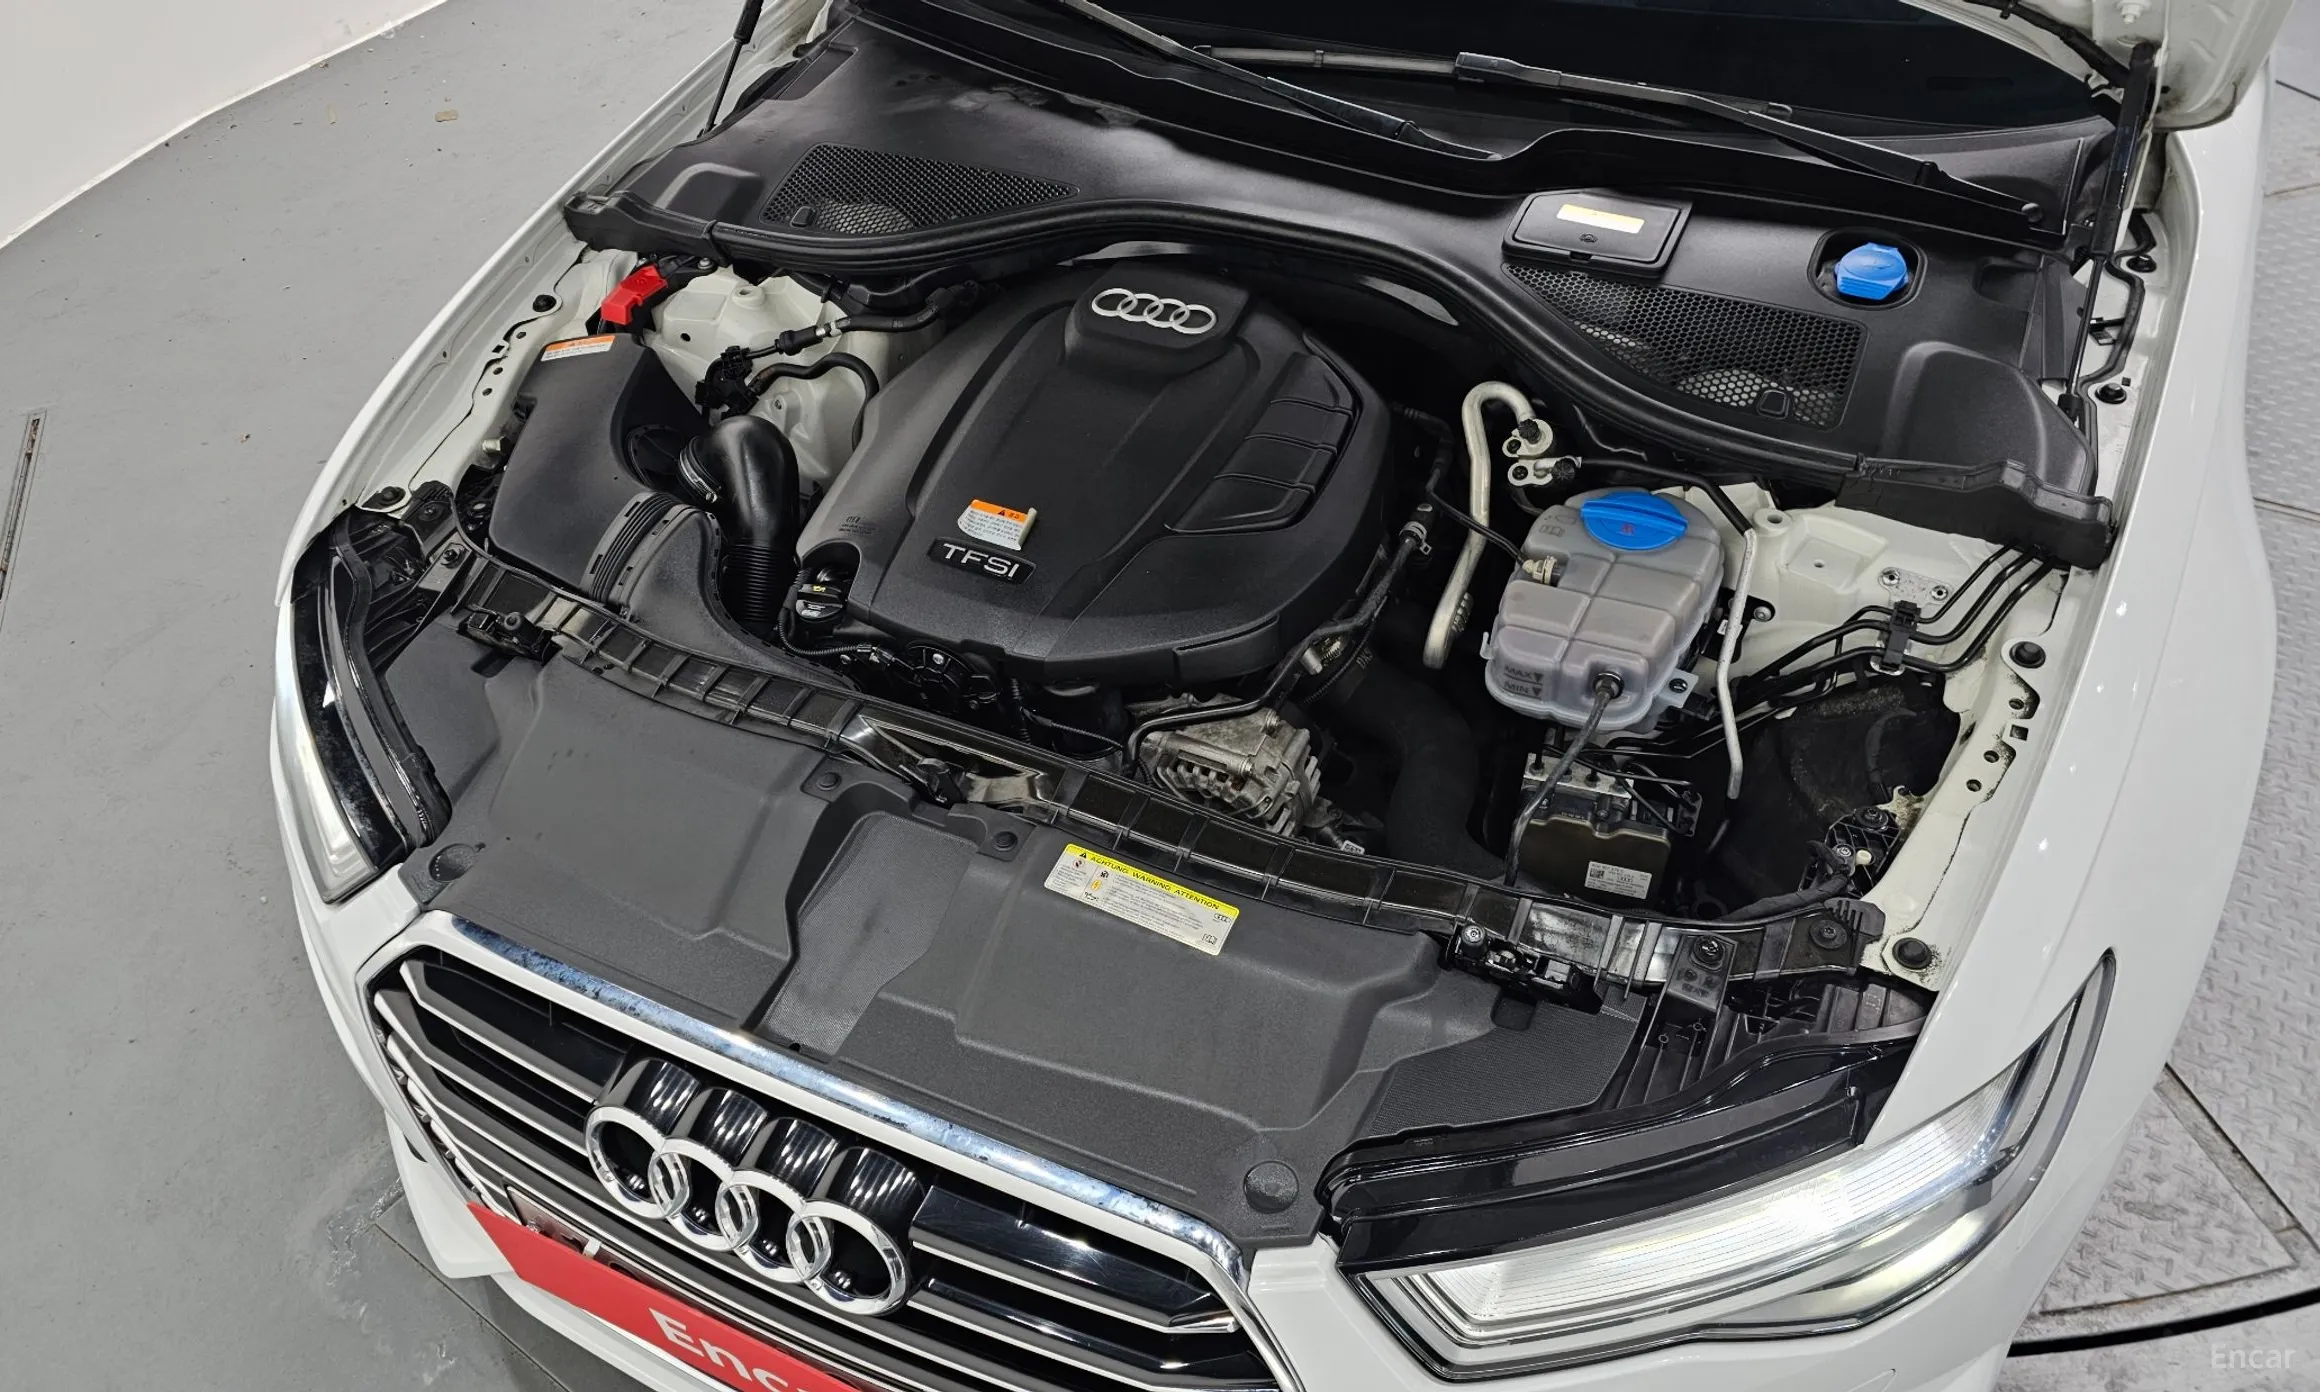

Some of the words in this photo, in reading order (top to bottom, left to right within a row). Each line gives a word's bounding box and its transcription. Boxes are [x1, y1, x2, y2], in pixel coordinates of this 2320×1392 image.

[943, 543, 1020, 578] TFSI
[1504, 664, 1533, 680] MAX
[1504, 681, 1529, 694] MIN
[1090, 856, 1129, 874] ACHTUNG
[1132, 871, 1172, 892] WARNING
[1174, 888, 1220, 910] ATTENTION
[648, 1307, 805, 1392] Enc
